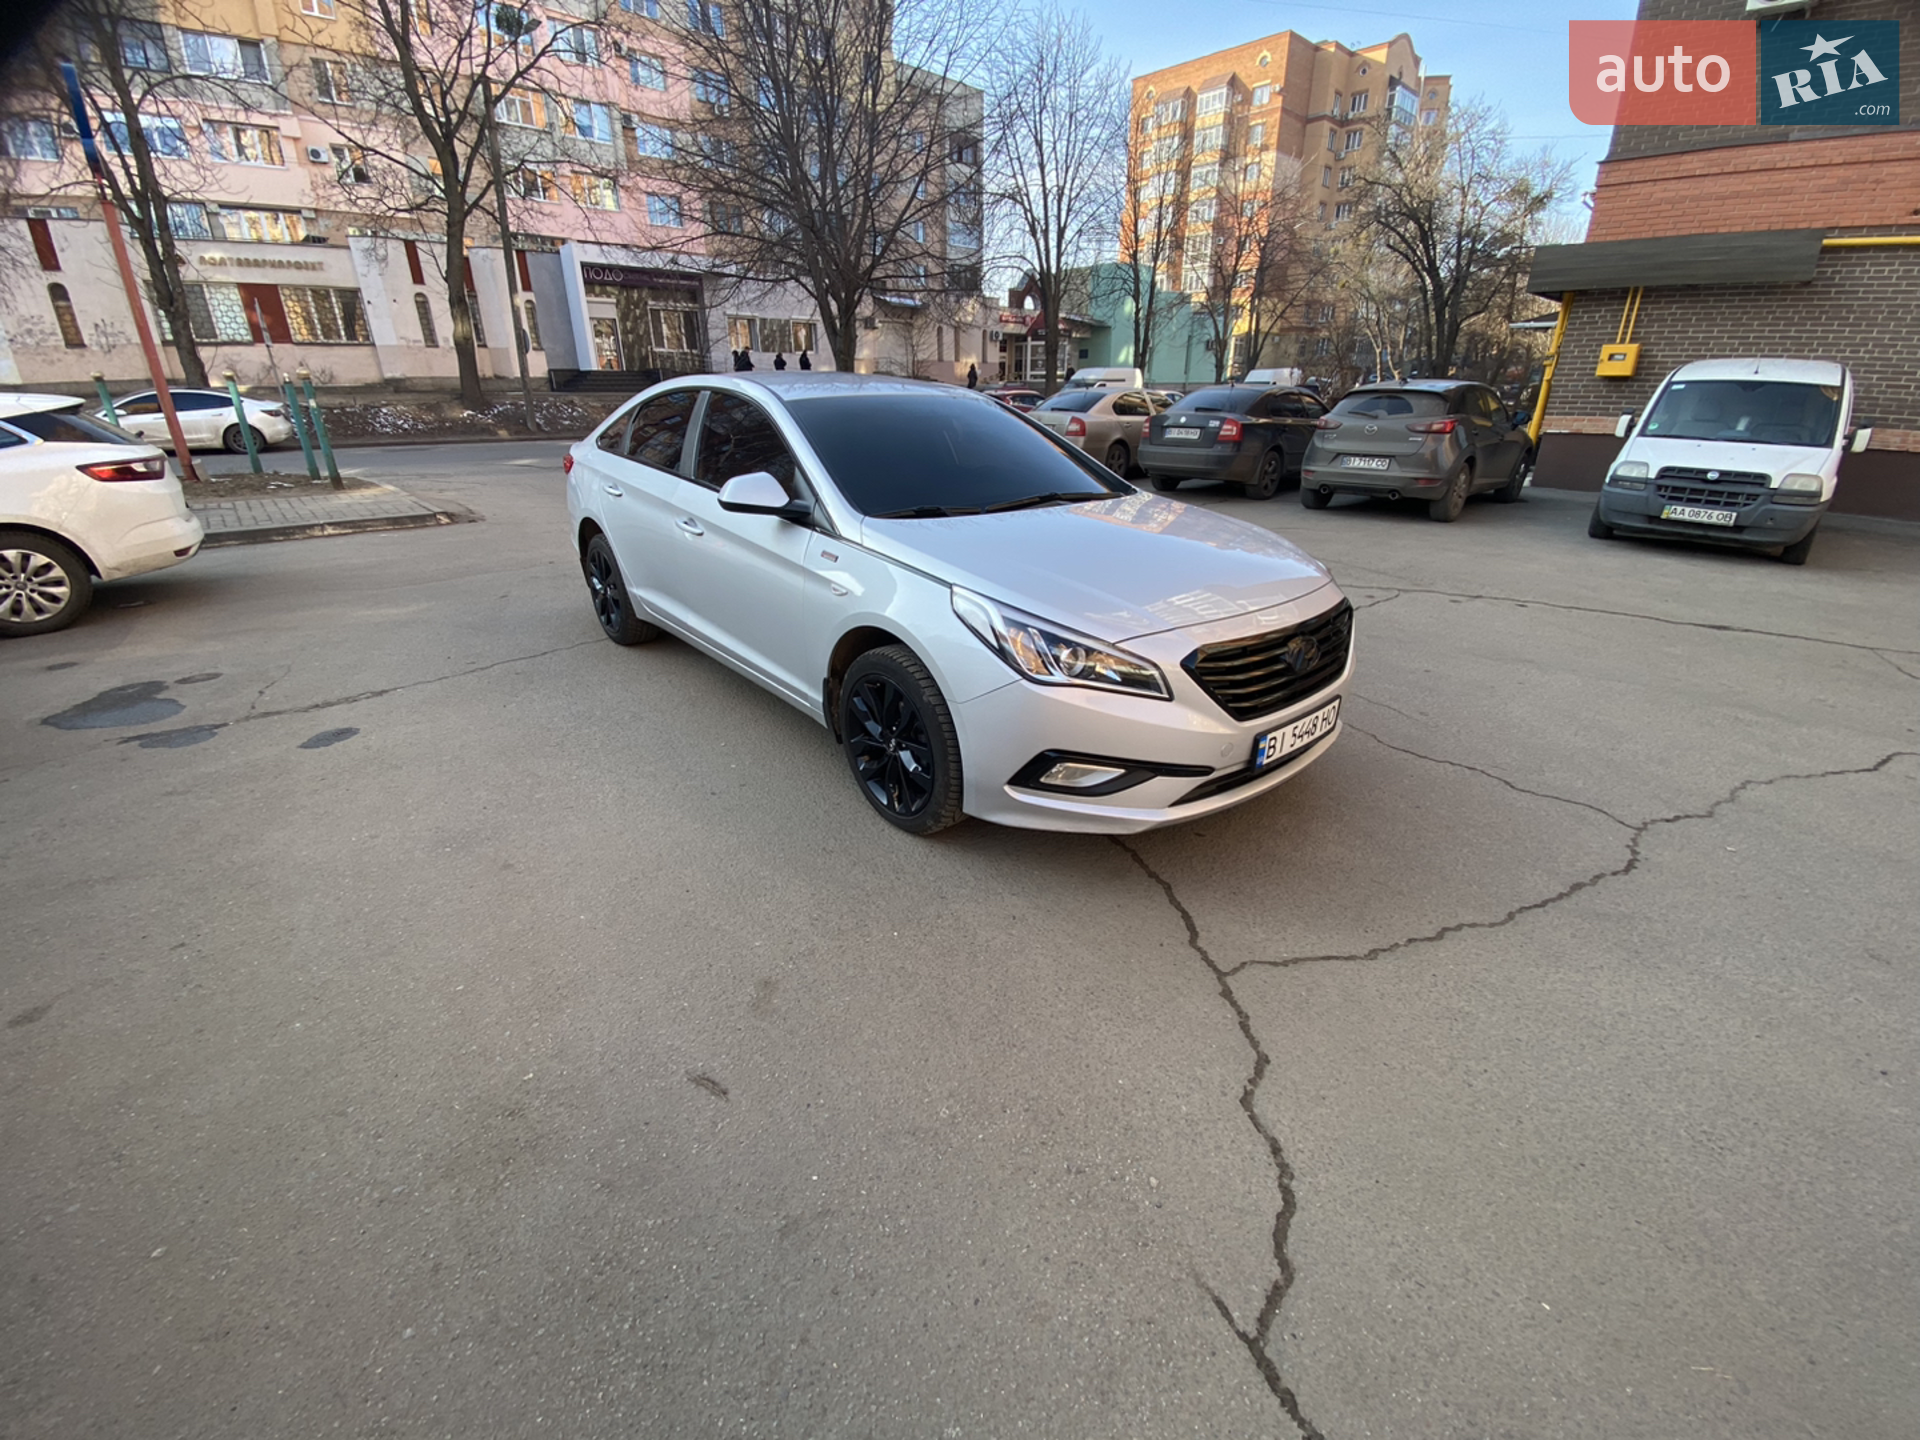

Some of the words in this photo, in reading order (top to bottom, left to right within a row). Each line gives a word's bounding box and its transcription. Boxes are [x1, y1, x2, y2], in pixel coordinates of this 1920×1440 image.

[1376, 459, 1388, 468] CO
[1670, 507, 1686, 517] AA
[1688, 509, 1714, 521] 0876
[1716, 512, 1733, 523] OB
[1265, 731, 1287, 760] BI
[1290, 715, 1319, 748] 5448
[1319, 705, 1337, 733] HO
